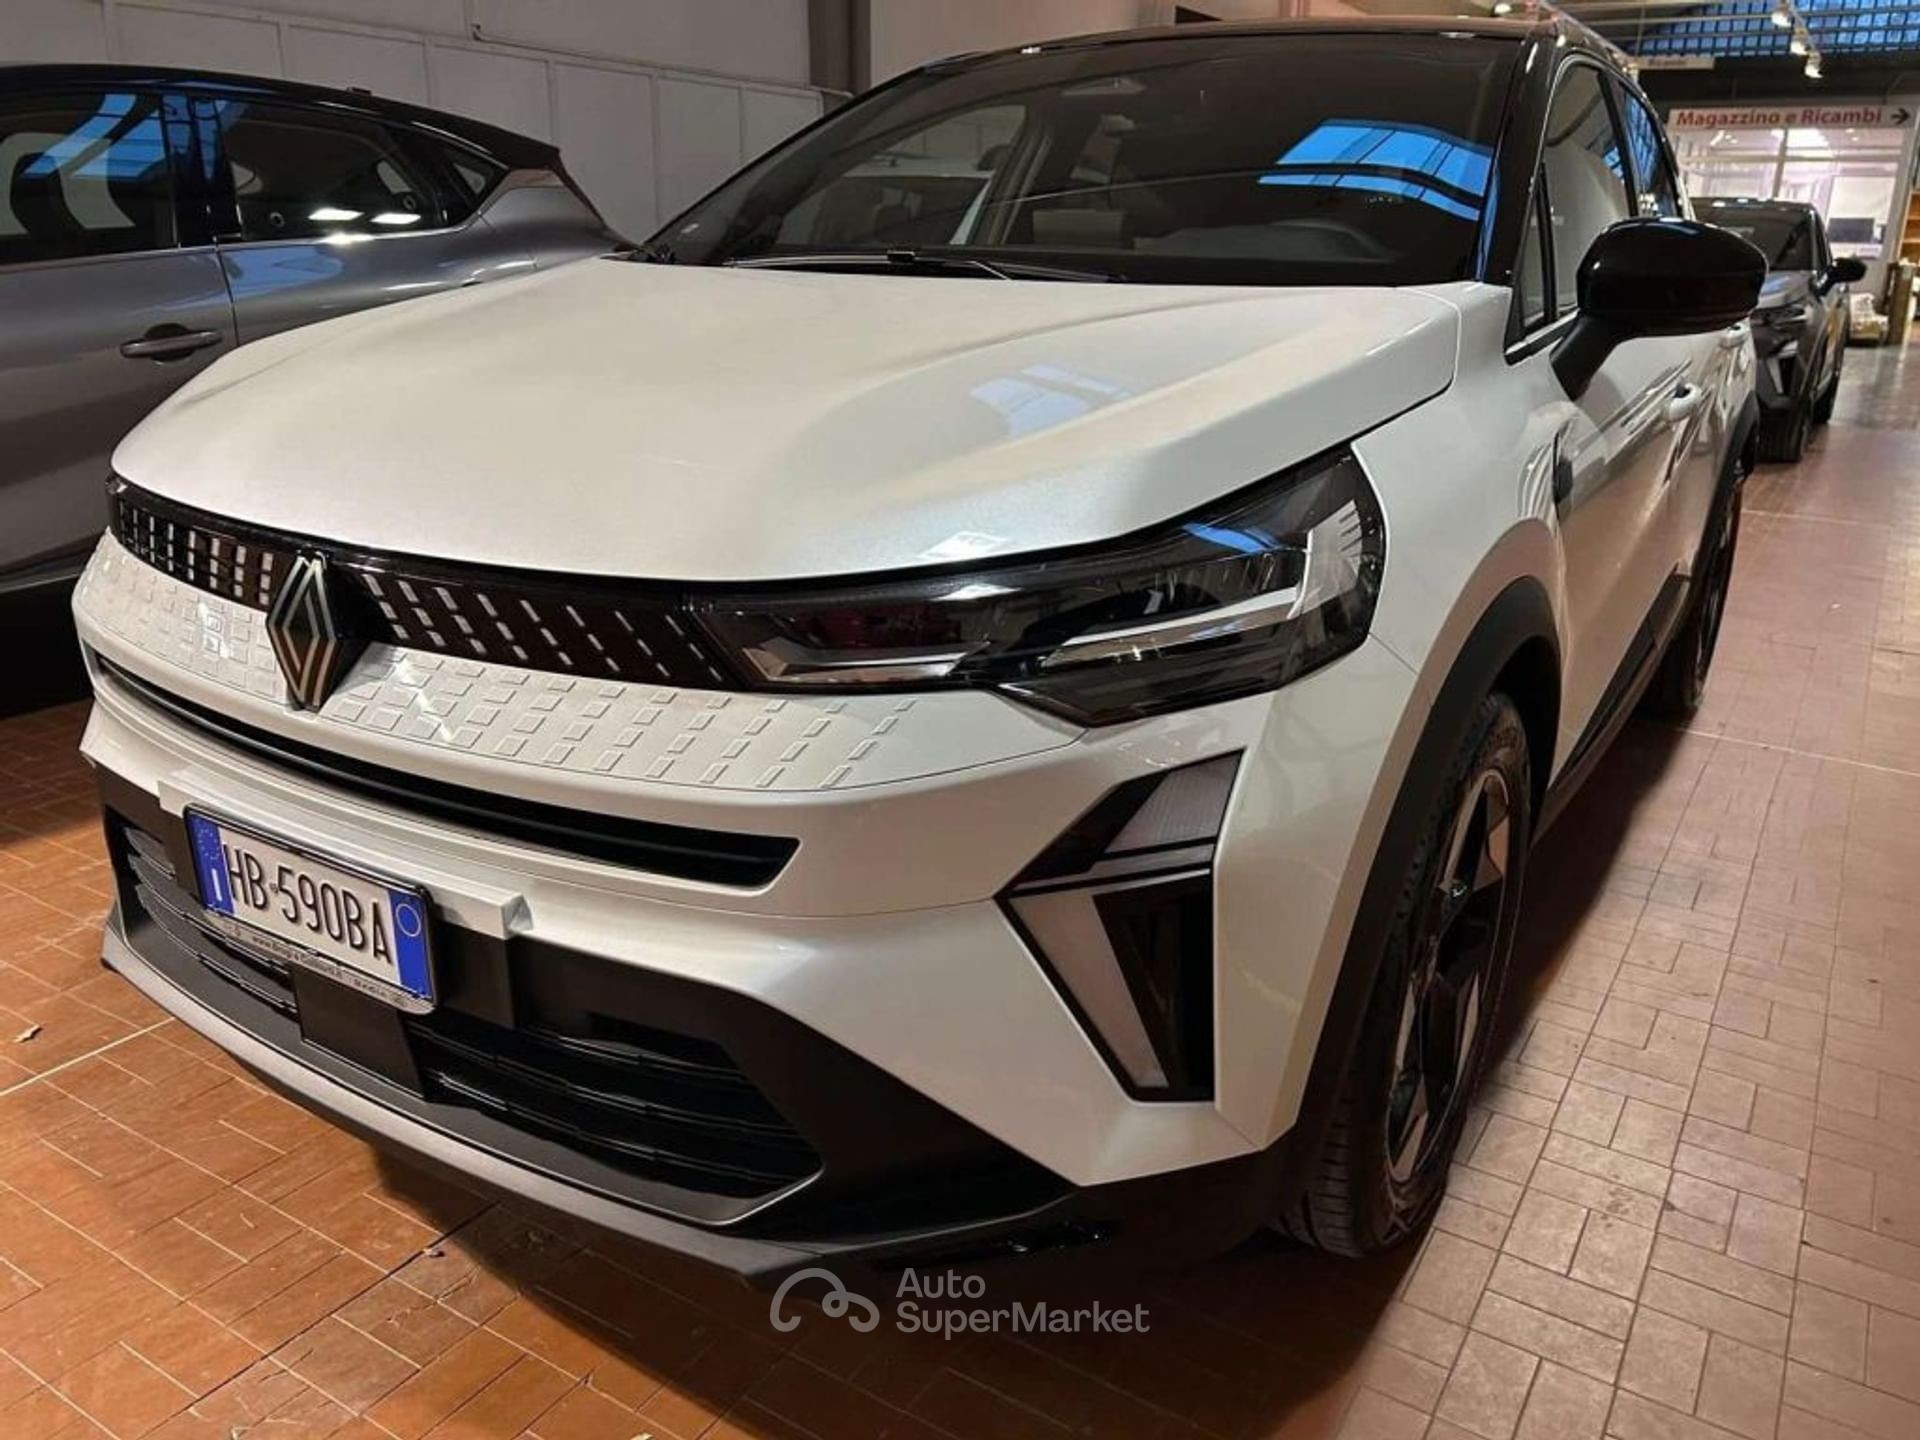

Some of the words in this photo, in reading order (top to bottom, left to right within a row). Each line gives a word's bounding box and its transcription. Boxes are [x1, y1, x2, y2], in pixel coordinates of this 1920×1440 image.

[1676, 109, 1780, 129] Magazzino
[1785, 112, 1798, 125] e
[1801, 107, 1882, 124] Ricambi
